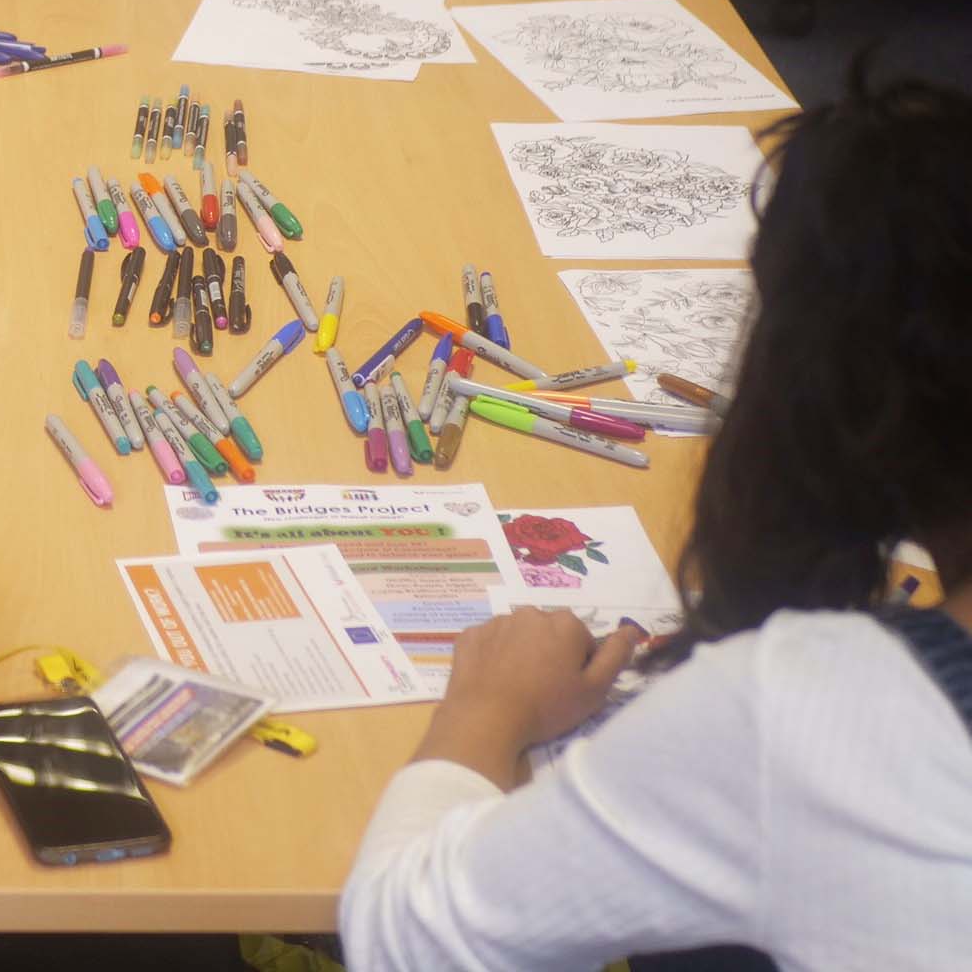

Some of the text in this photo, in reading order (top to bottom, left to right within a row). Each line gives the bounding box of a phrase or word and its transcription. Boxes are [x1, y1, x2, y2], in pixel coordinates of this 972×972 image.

[232, 503, 431, 516] The Bridges Project
[276, 528, 305, 539] all
[310, 527, 373, 538] about
